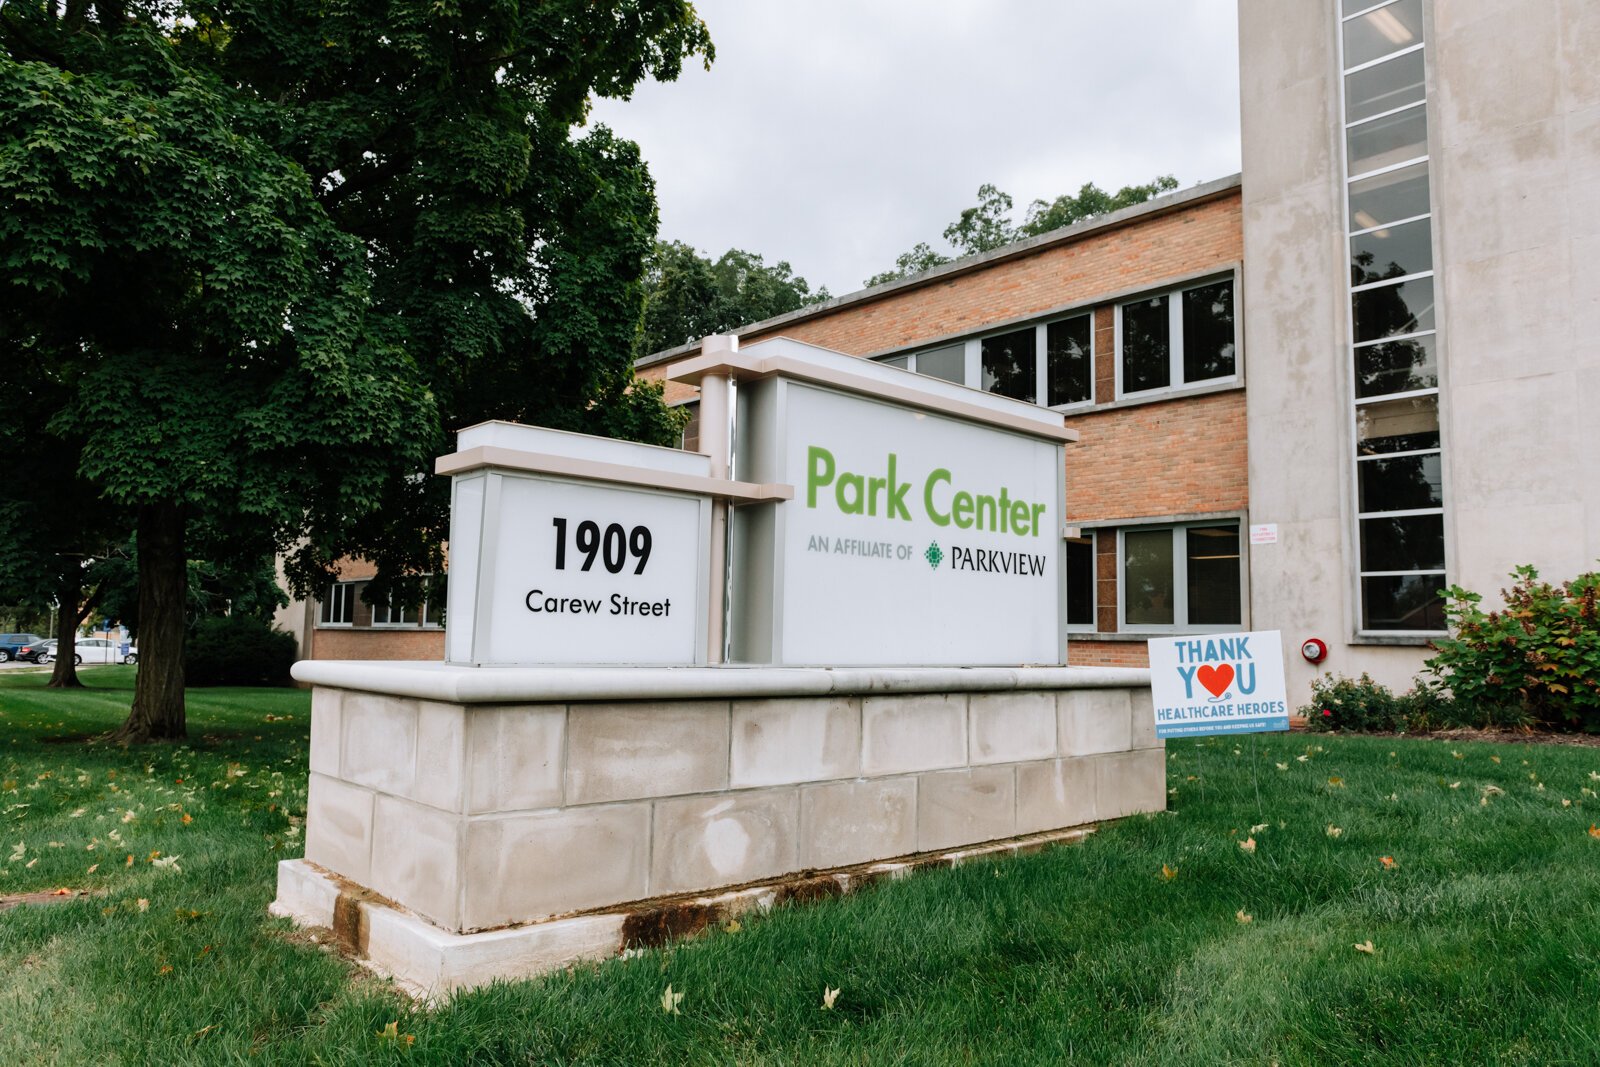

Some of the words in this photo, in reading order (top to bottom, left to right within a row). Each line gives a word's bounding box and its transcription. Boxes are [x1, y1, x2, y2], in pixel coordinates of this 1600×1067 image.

[807, 445, 912, 521] Park
[923, 468, 1046, 537] Center
[553, 517, 652, 575] 1909
[808, 535, 829, 552] AN
[833, 538, 892, 559] AFFILIATE
[898, 544, 912, 560] OF
[951, 546, 1046, 576] PARKVIEW
[526, 590, 601, 614] Carew
[610, 593, 670, 616] Street
[1175, 637, 1252, 663] THANK
[1177, 663, 1255, 698] YU
[1158, 705, 1234, 720] HEALTHCARE
[1238, 702, 1284, 715] HEROES
